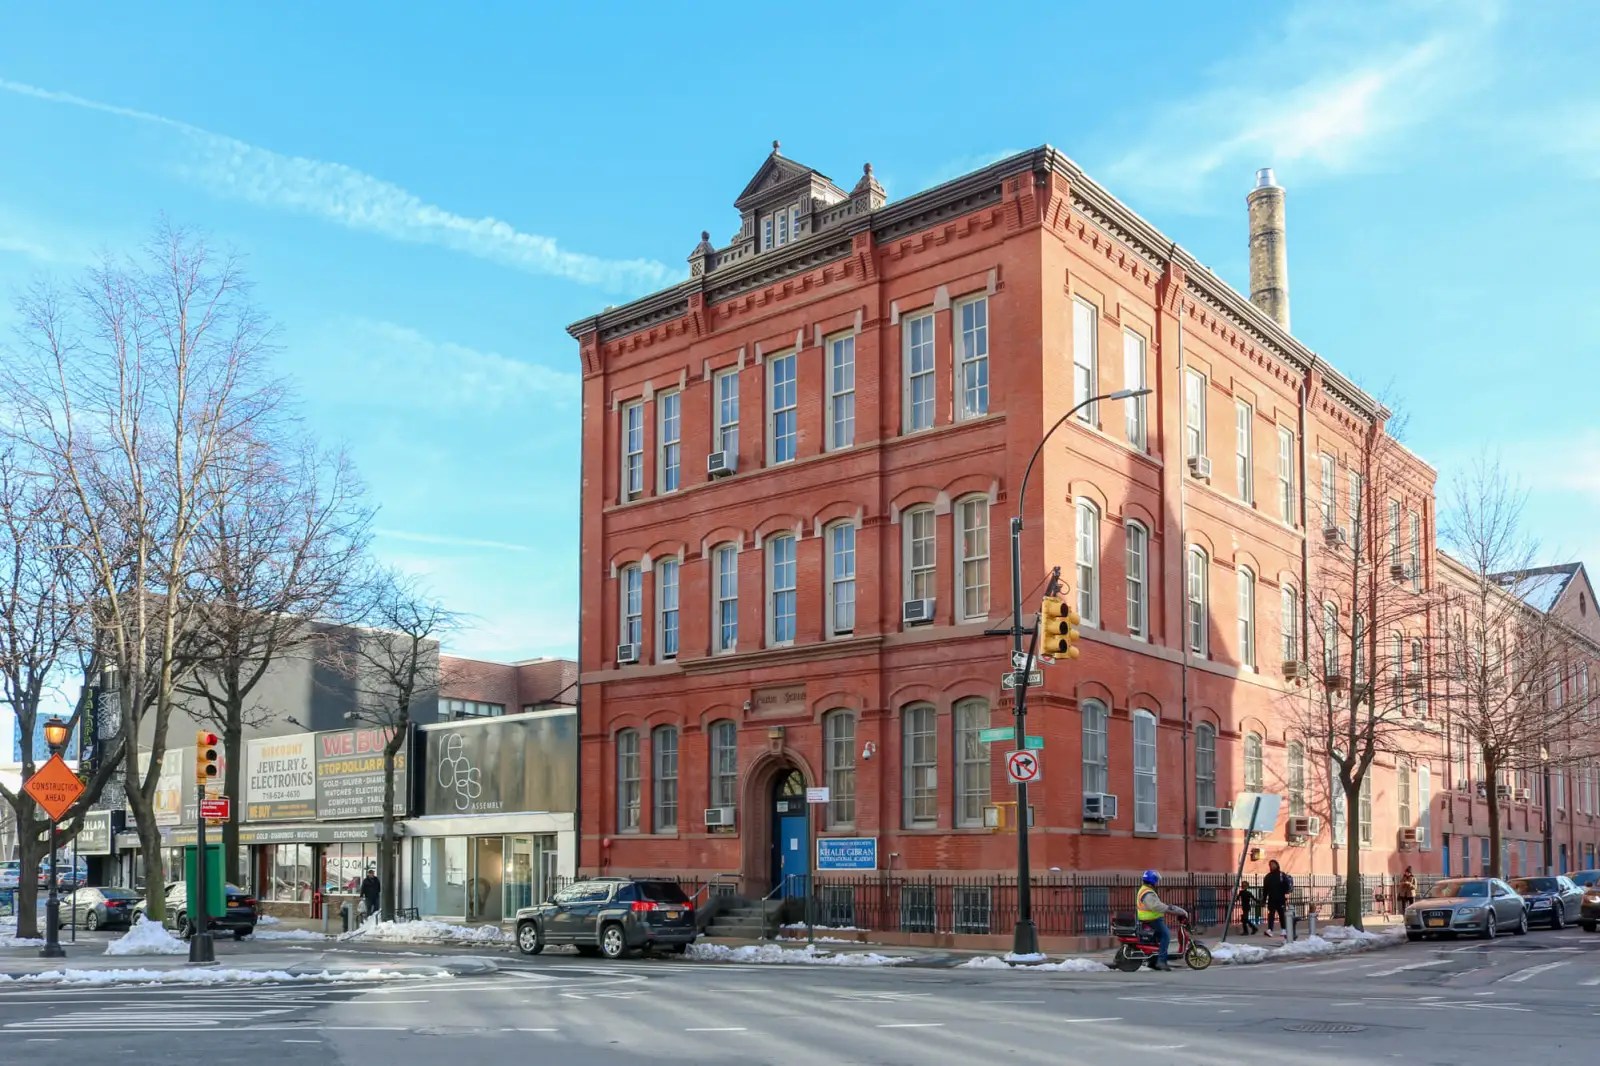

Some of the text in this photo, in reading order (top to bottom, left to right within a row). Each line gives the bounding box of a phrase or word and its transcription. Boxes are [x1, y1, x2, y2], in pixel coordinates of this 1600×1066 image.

[322, 732, 354, 757] WE
[257, 757, 308, 774] JEWELRY &
[341, 759, 375, 773] DOLLAR
[251, 771, 313, 789] ELECTRONICS
[323, 780, 339, 788] GOLD
[343, 778, 363, 786] SILVER
[31, 782, 78, 791] CONSTRUCTION
[45, 794, 66, 802] AHEAD
[328, 797, 363, 806] COMPUTERS
[472, 801, 504, 809] ASSEMBLY
[81, 831, 94, 842] JAR
[333, 830, 368, 838] ELECTRONICS
[820, 848, 873, 856] KHALIL GIBRAN
